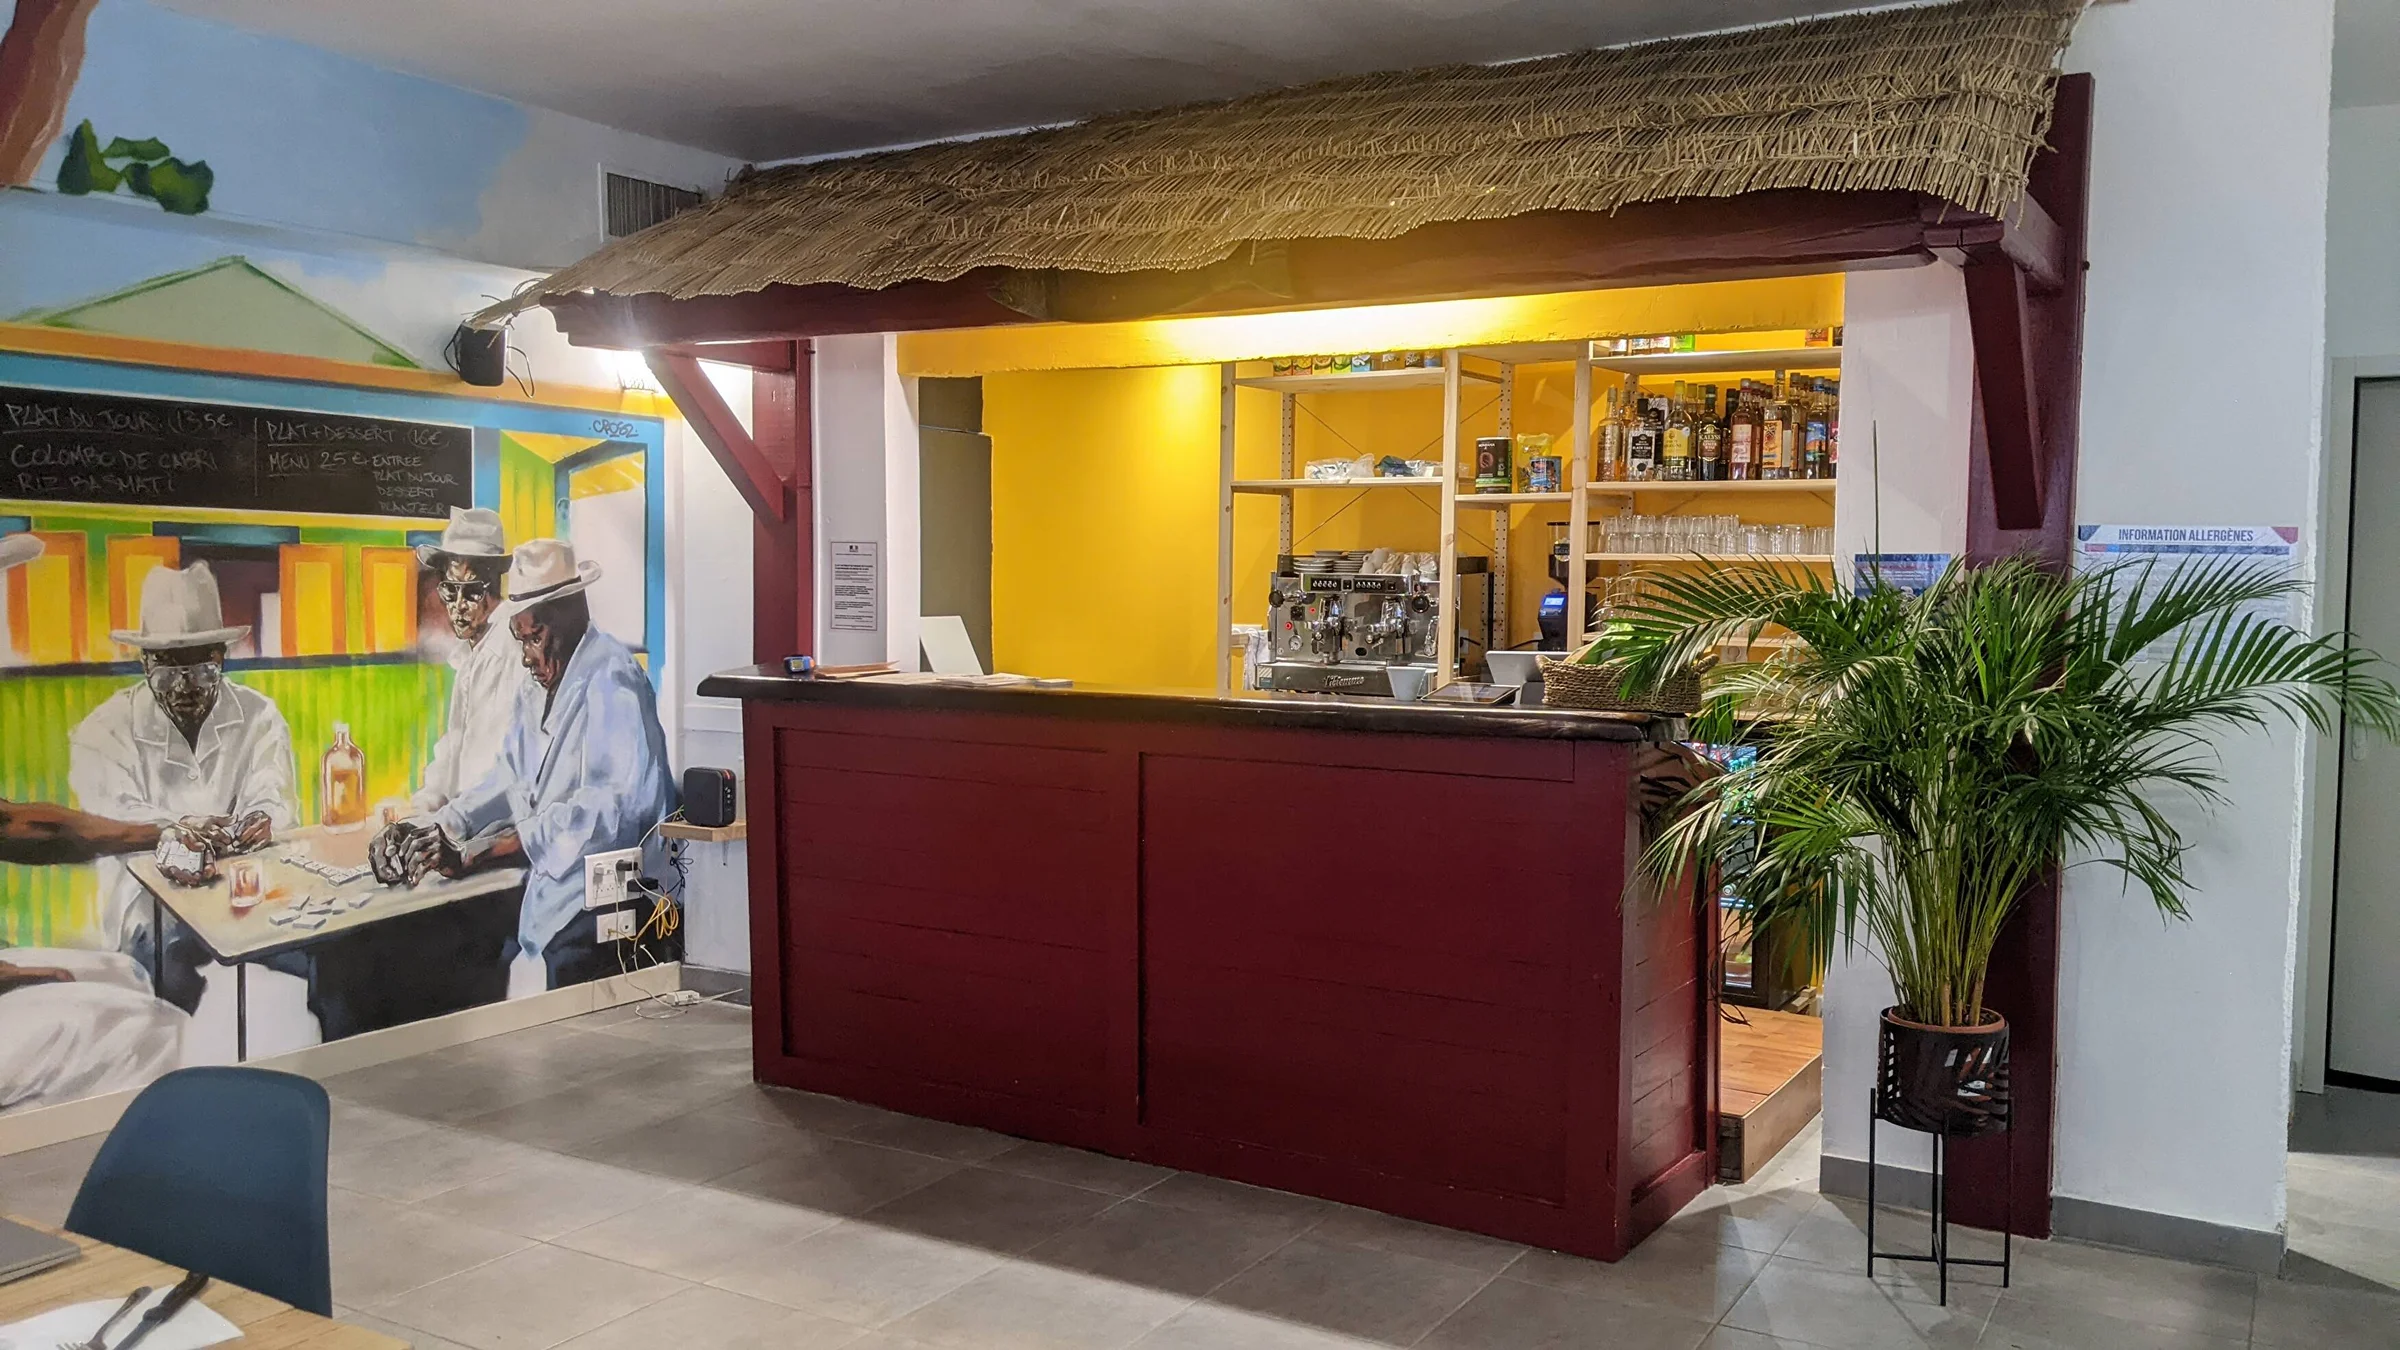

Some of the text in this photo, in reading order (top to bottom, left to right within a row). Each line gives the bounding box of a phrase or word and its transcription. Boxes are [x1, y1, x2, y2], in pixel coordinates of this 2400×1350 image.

[5, 403, 61, 427] PLAT
[68, 407, 94, 427] DU
[11, 443, 116, 469] COLOMBO
[119, 449, 152, 471] DE
[269, 451, 310, 472] MENU
[372, 469, 406, 481] PLAT
[423, 472, 459, 485] JOUR
[2118, 528, 2255, 542] INFORMATION ALLERGÈNES
